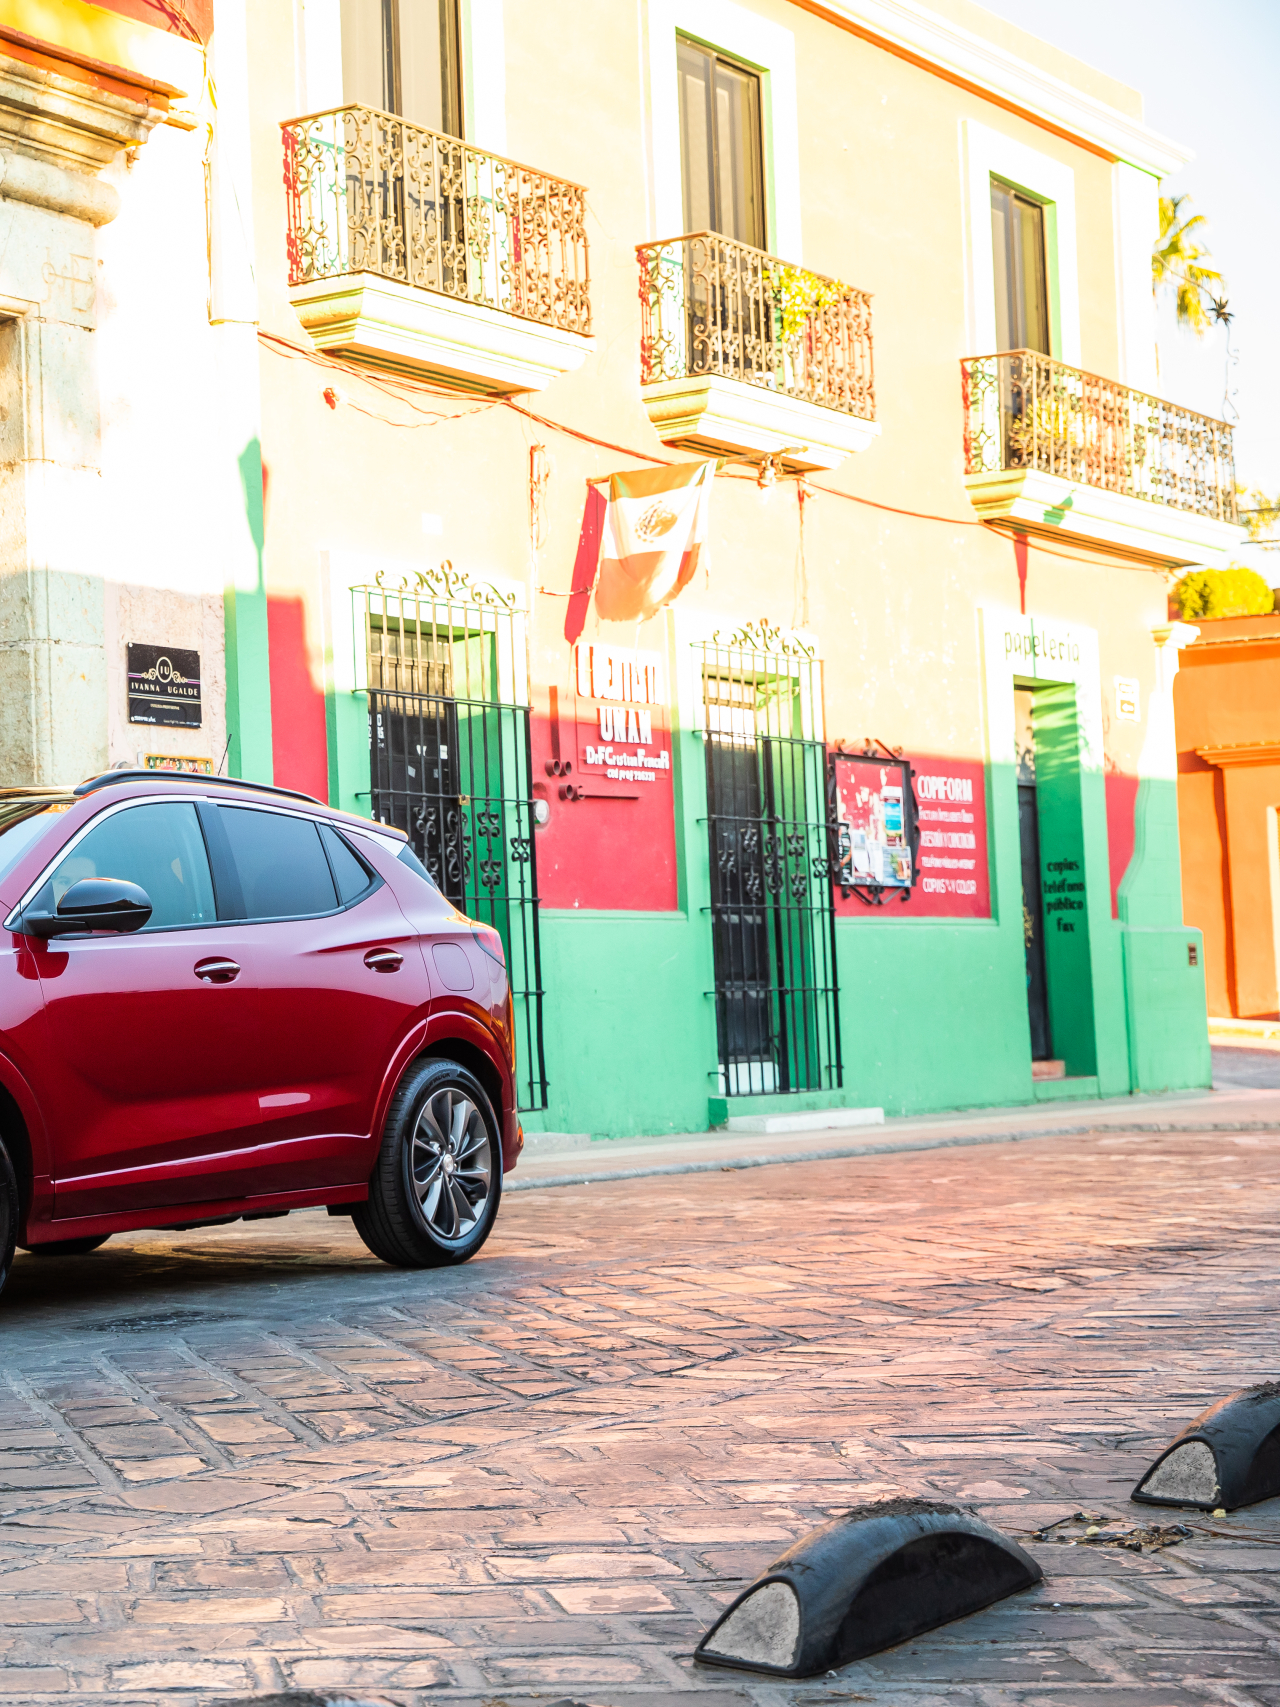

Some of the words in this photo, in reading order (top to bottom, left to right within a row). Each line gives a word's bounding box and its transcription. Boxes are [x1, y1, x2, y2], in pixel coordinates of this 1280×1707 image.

[160, 665, 170, 675] IU
[131, 681, 160, 692] IVANNA
[167, 685, 198, 696] UGALDE
[600, 705, 653, 745] UNAM
[150, 758, 210, 771] ARTESANIAS
